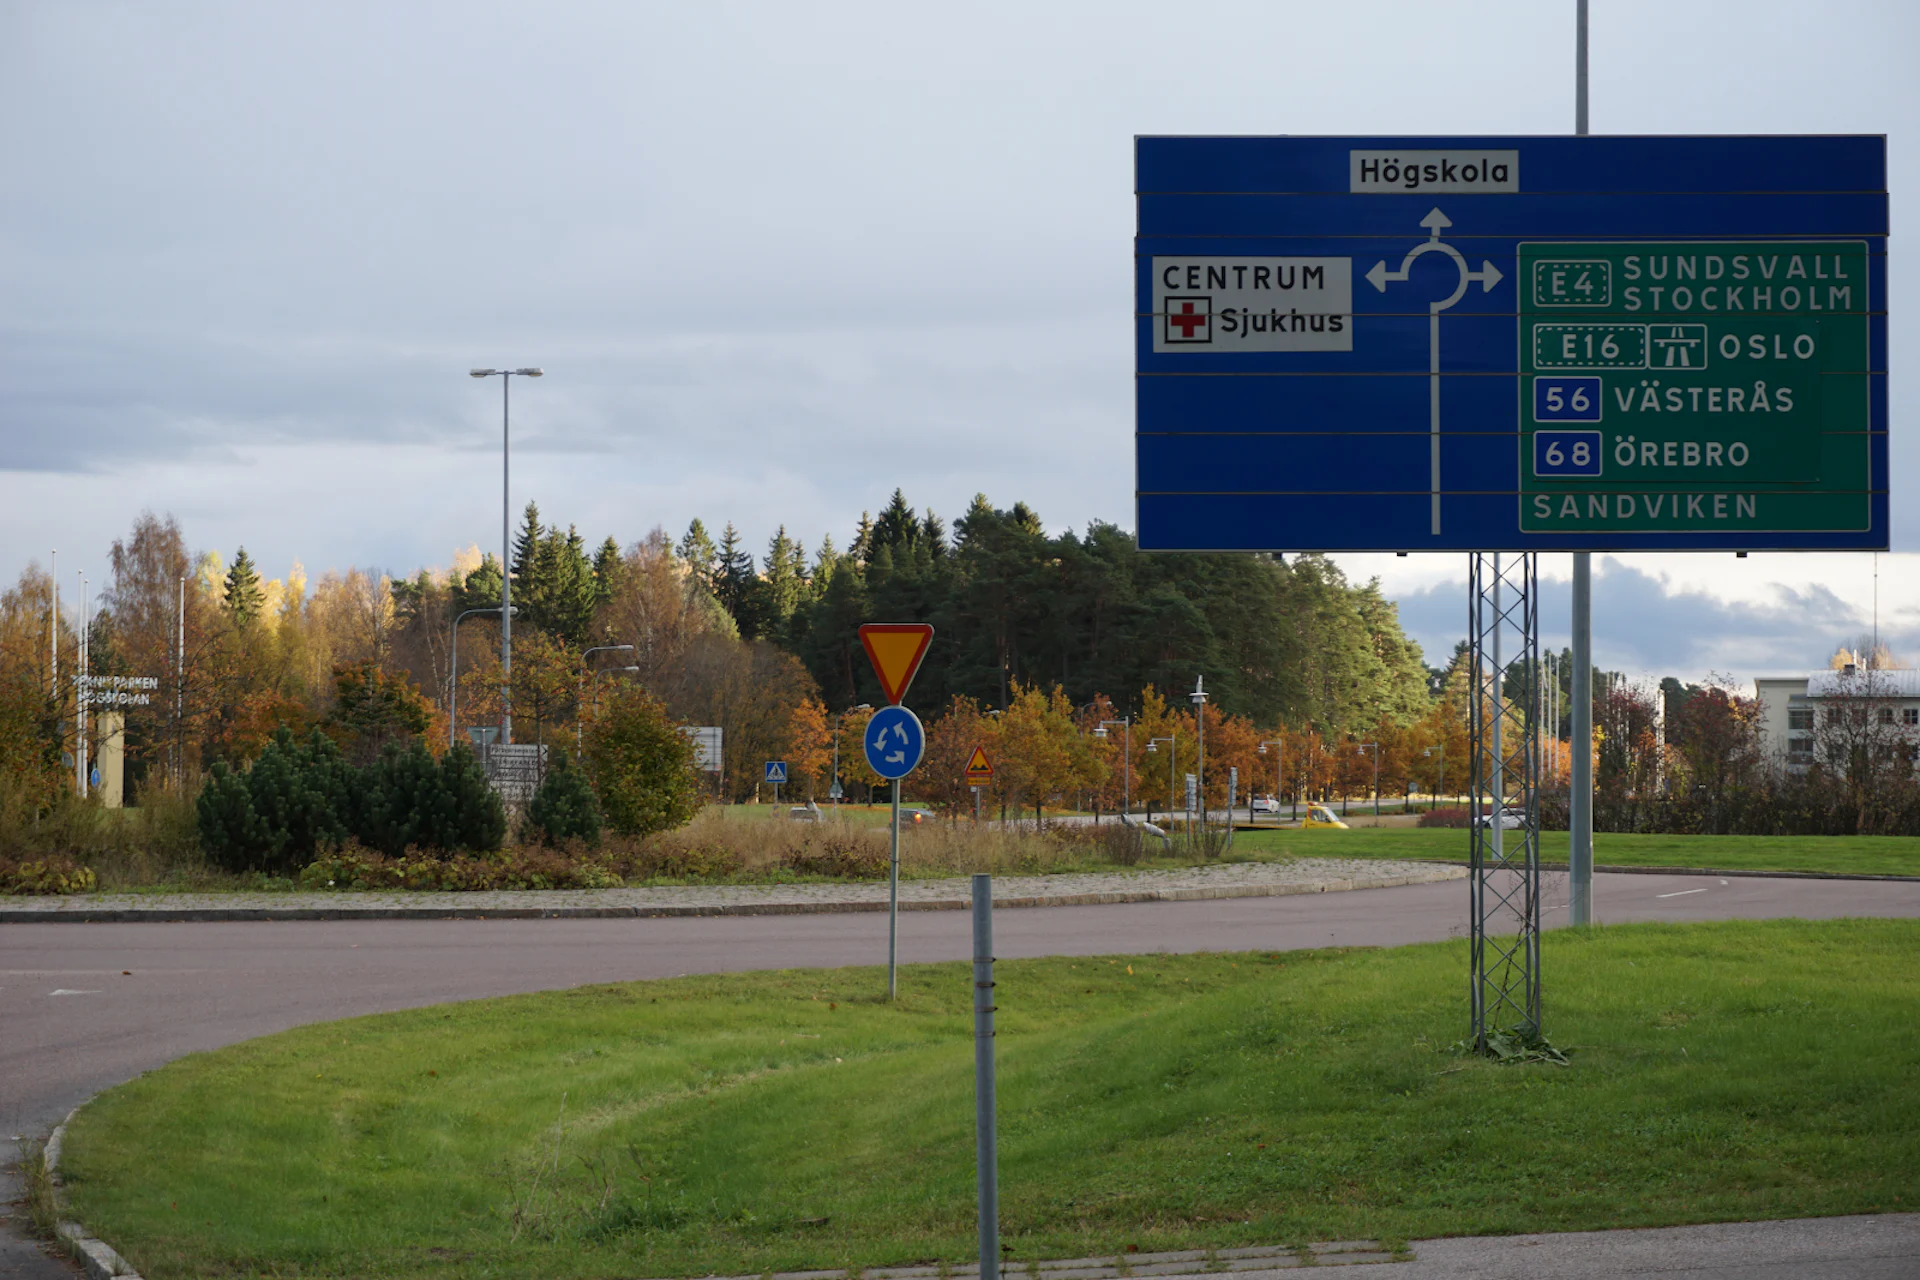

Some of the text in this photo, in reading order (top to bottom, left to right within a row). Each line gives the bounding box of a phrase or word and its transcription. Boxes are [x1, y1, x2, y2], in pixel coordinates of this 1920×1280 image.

[1361, 158, 1509, 189] Högskola
[1163, 265, 1325, 290] CENTRUM
[1551, 255, 1848, 296] E4 SUNDSVALL
[1623, 285, 1852, 311] STOCKHOLM
[1220, 308, 1344, 338] Sjukhus
[1562, 333, 1815, 360] E16 OSLO
[1546, 380, 1794, 412] 56 VÄSTERÅS
[1546, 435, 1749, 467] 68 ÖREBRO
[1533, 494, 1756, 519] SANDVIKEN
